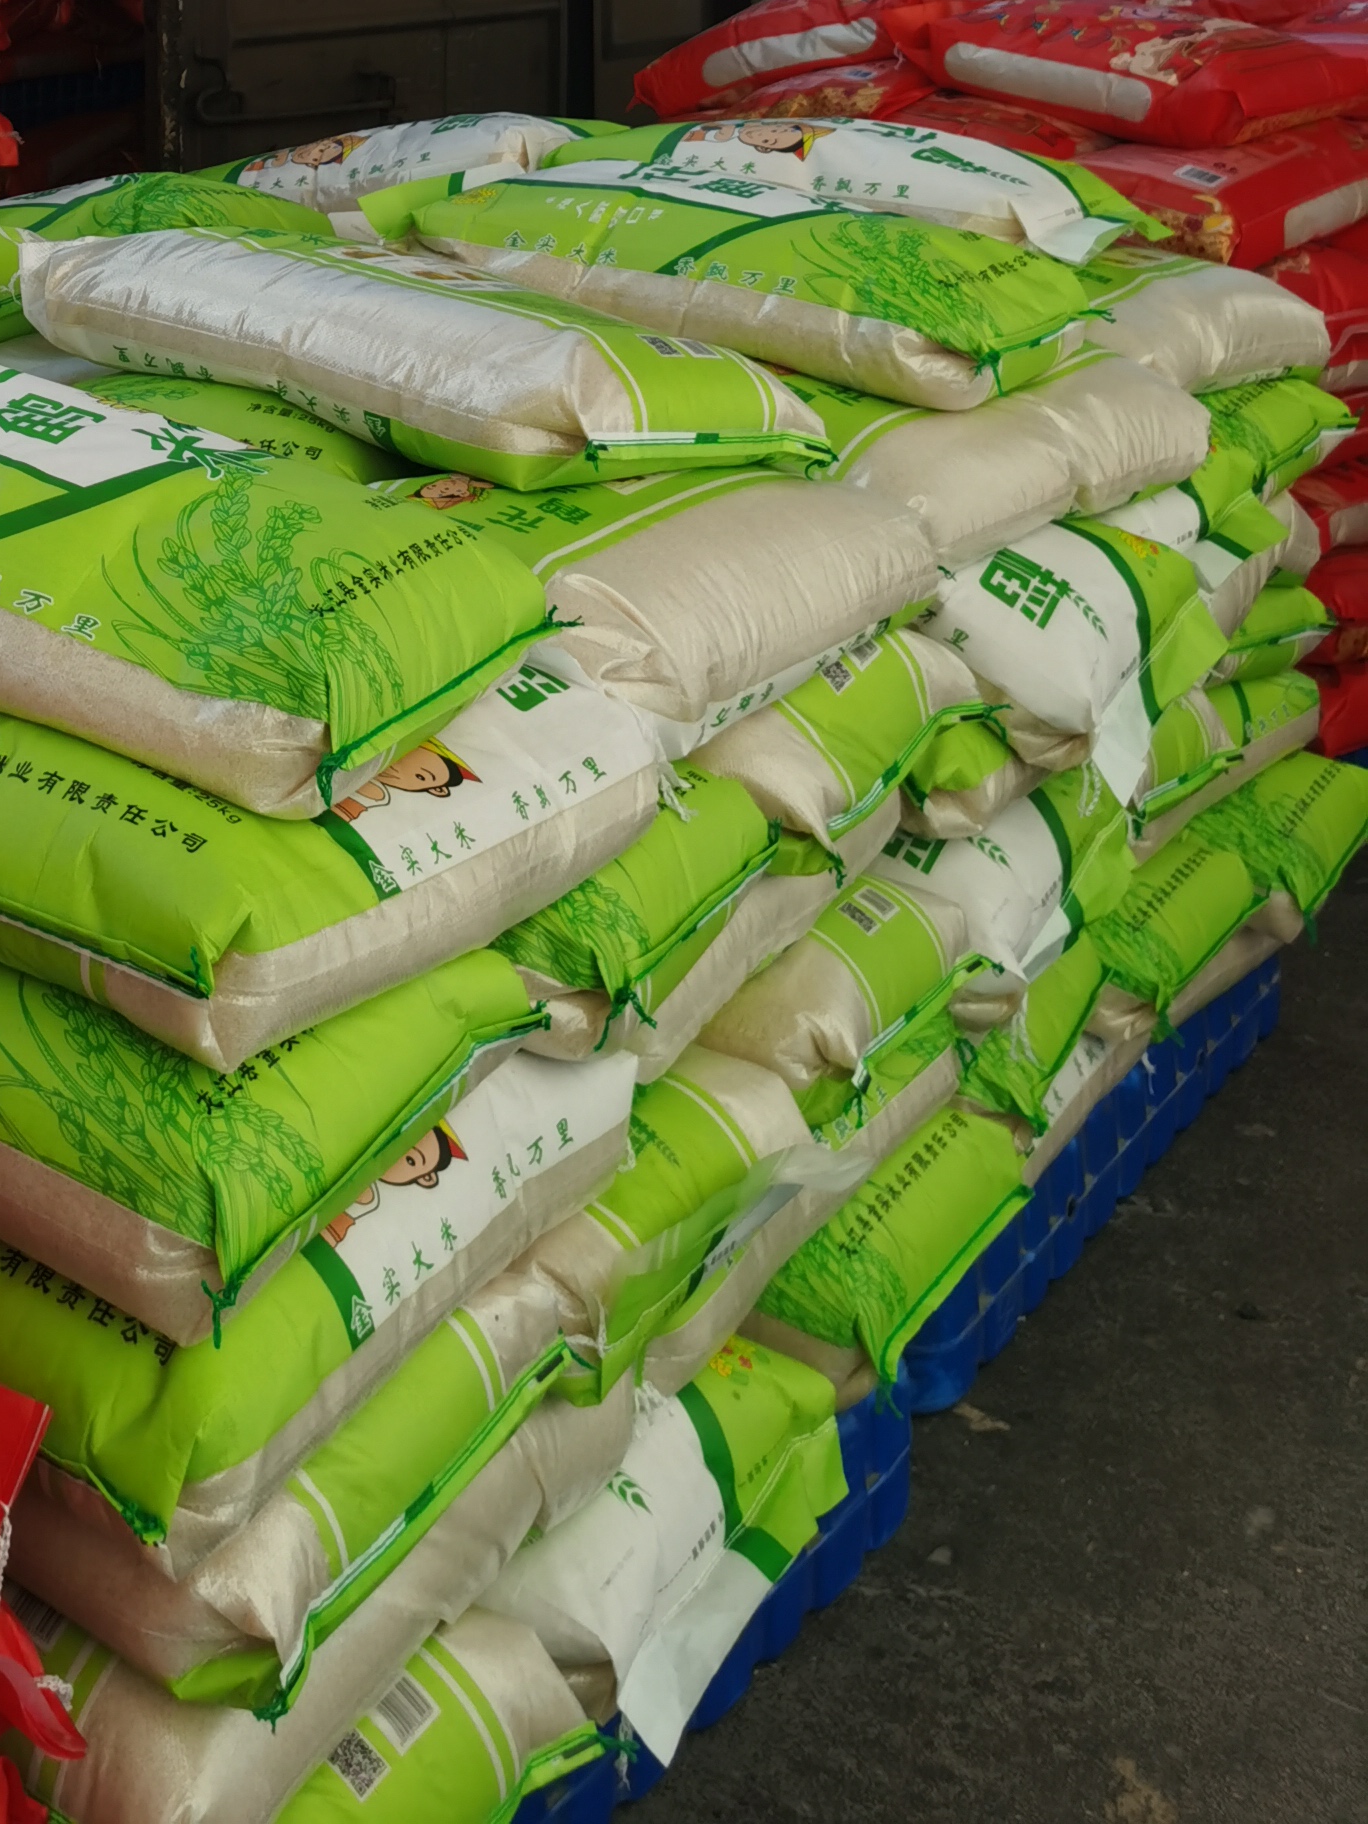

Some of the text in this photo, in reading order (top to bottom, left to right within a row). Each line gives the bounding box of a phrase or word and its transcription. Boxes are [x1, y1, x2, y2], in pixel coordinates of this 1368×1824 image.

[811, 175, 911, 200] 香飘万里
[504, 230, 798, 296] 金实大米 香飘万里
[308, 525, 479, 618] 龙江县金实米业有限责任公司
[372, 821, 478, 894] 金实大米
[350, 1221, 459, 1337] 金实大米
